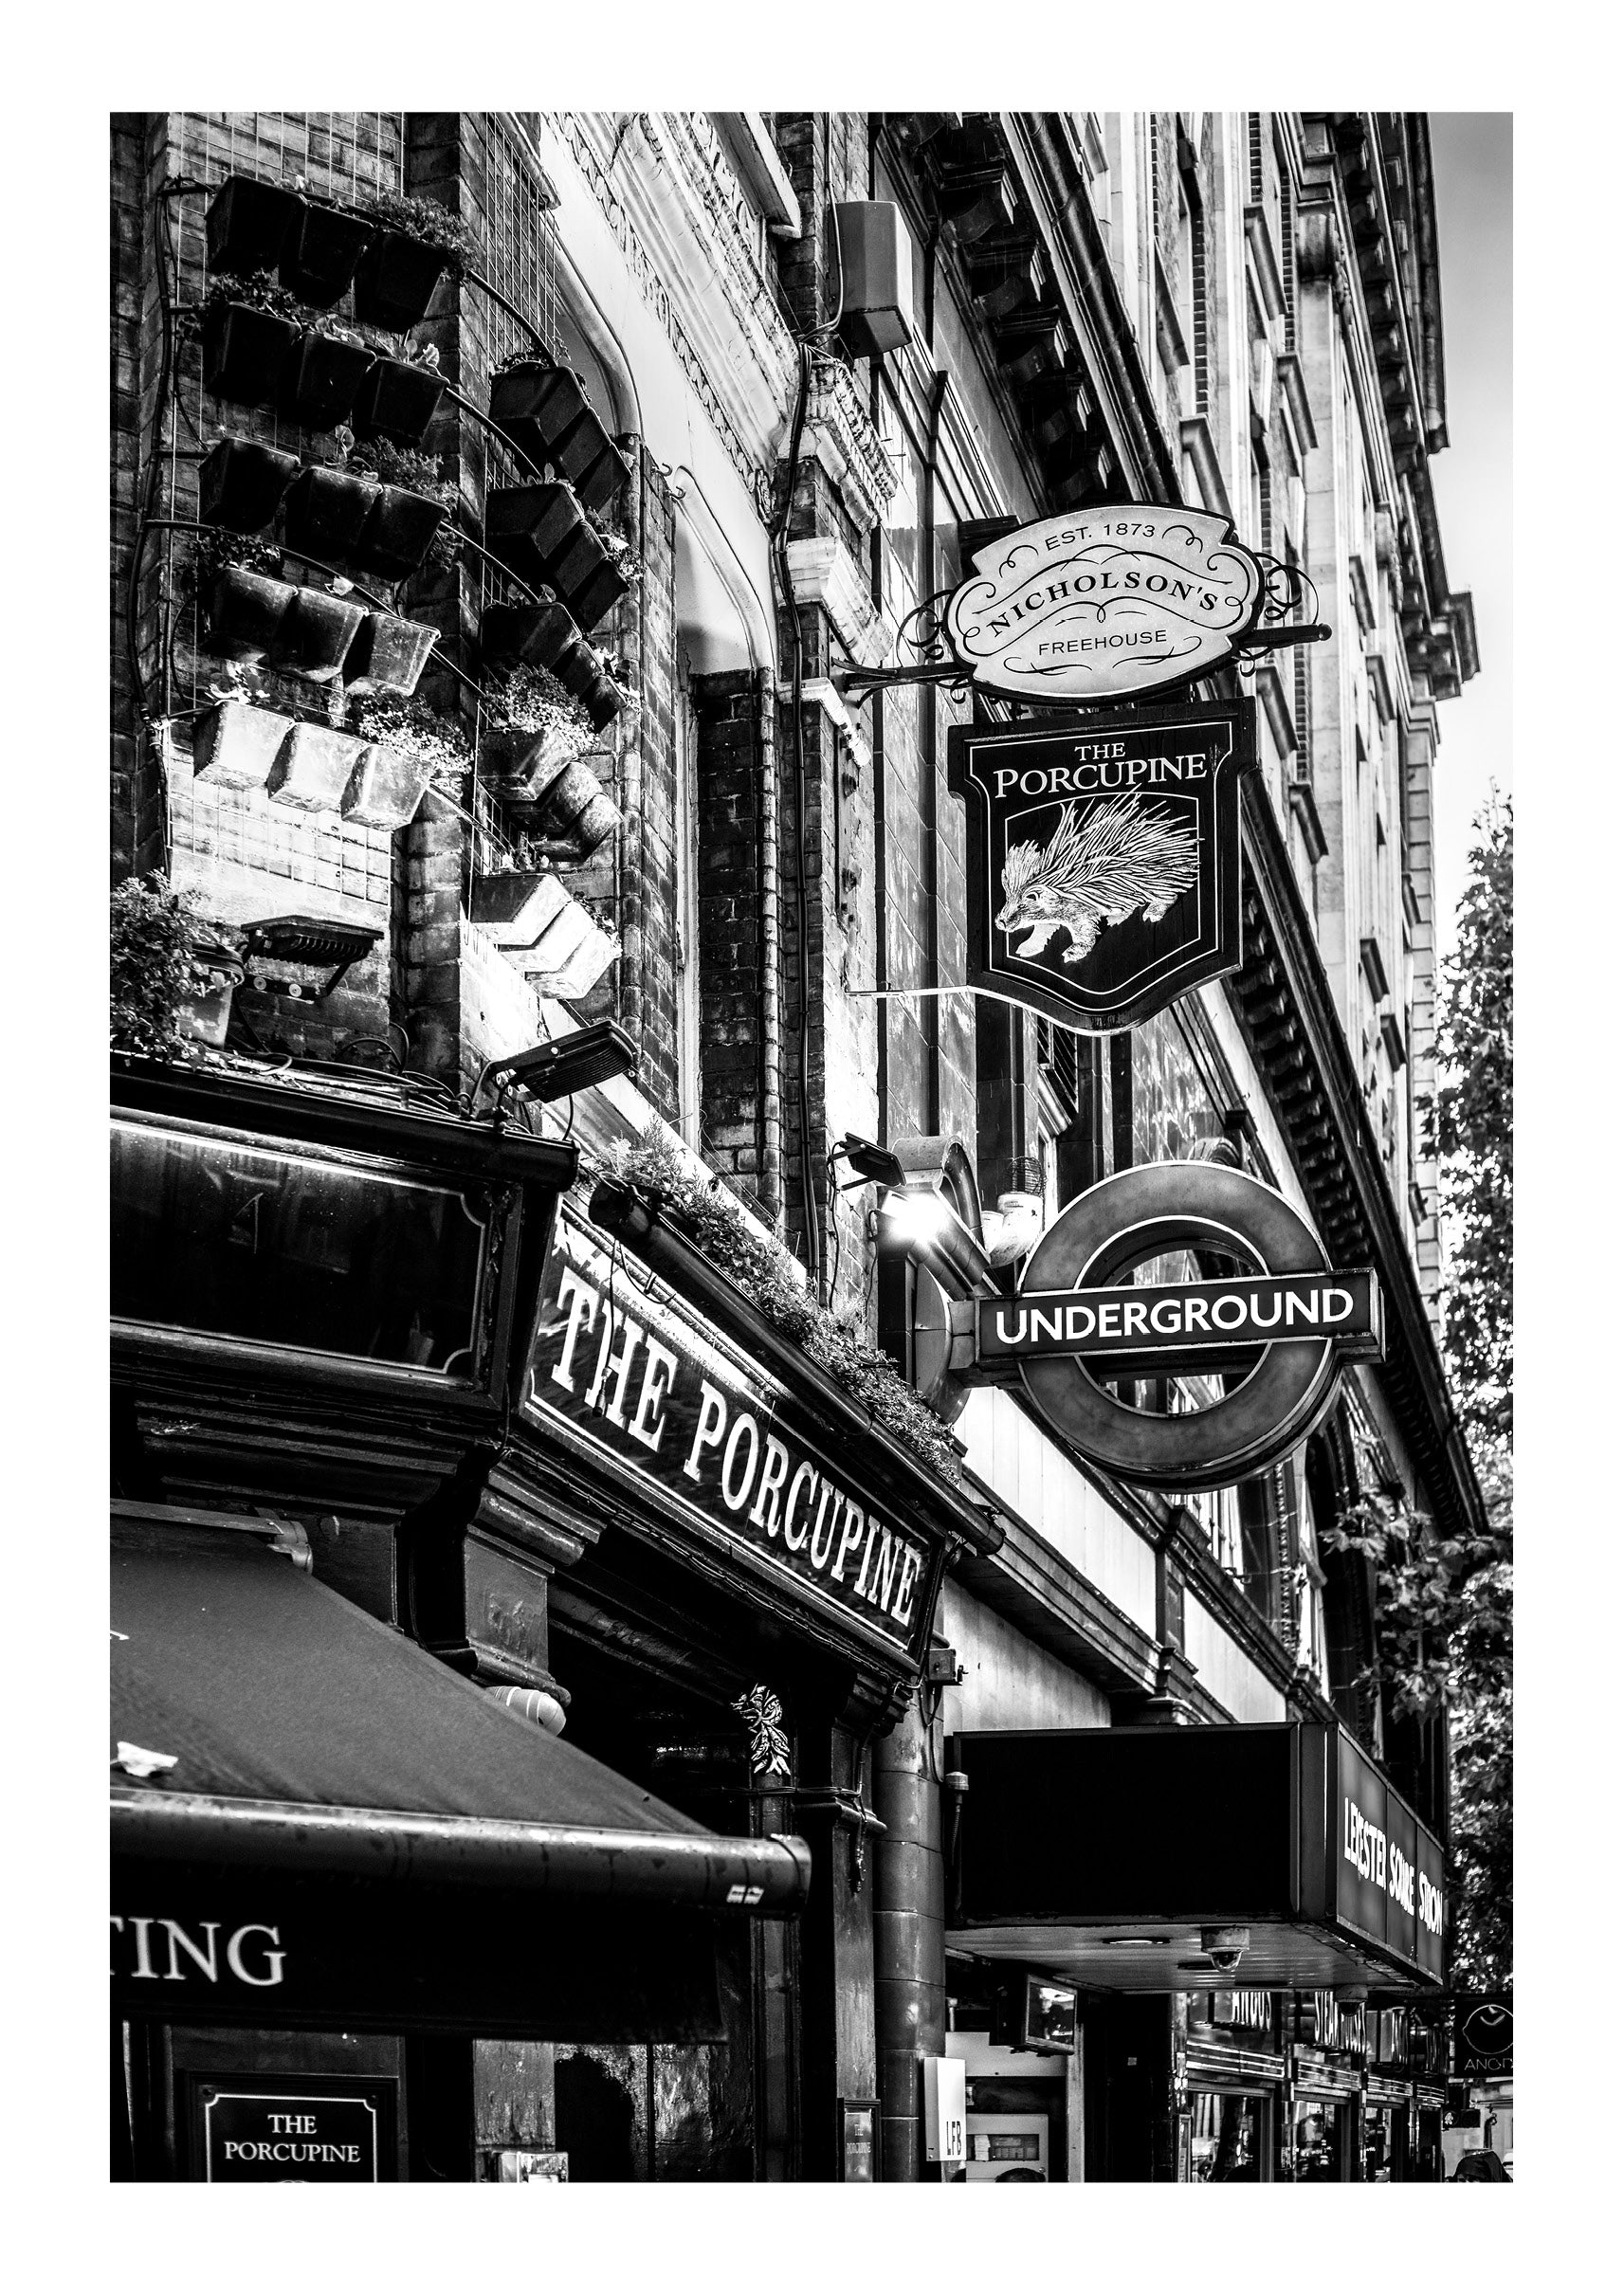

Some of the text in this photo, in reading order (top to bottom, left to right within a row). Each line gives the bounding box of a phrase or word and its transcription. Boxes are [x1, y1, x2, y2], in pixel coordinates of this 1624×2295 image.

[1045, 522, 1156, 551] EST. 1873
[986, 571, 1218, 638] NICHOLSON'S
[1038, 629, 1167, 656] FREEHOUSE
[1074, 742, 1125, 761] THE
[993, 753, 1208, 799] PORCUPINE
[995, 1288, 1354, 1344] UNDERGROUND
[550, 1266, 922, 1627] THE PORCUPINE
[267, 2114, 317, 2135] THE
[224, 2141, 361, 2163] PORCUPINE
